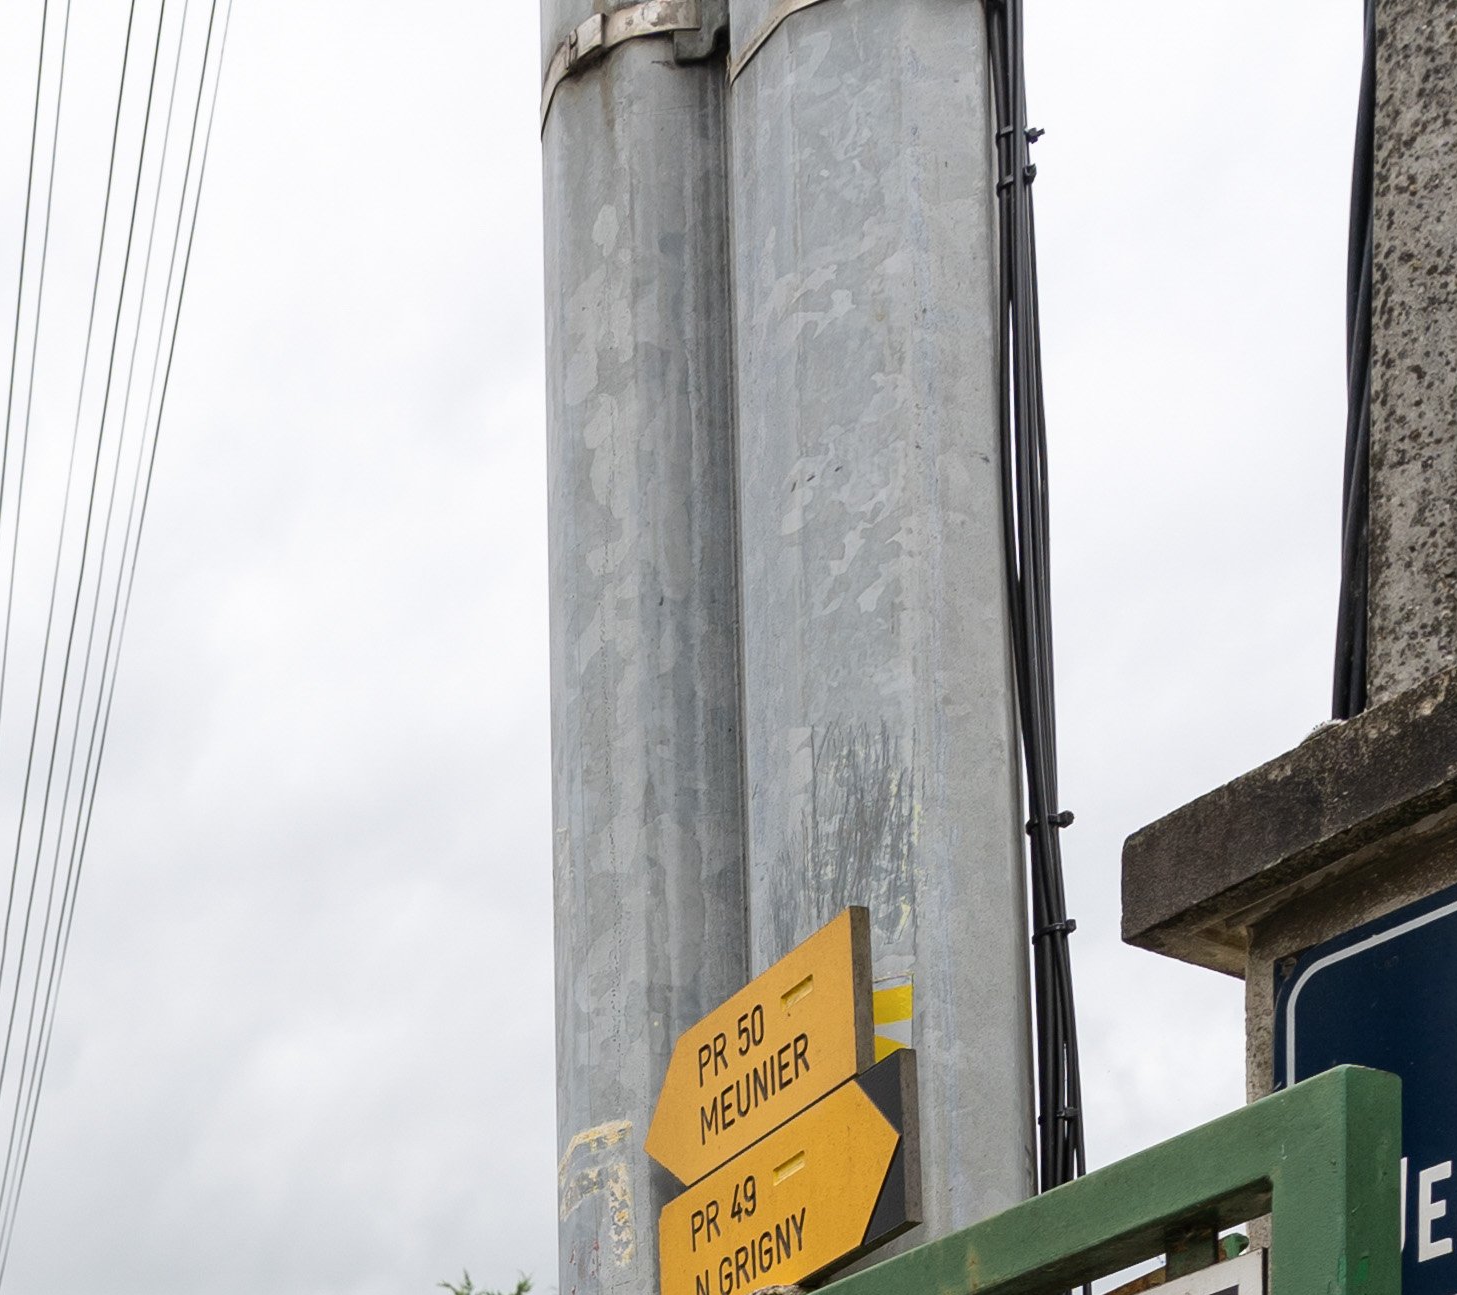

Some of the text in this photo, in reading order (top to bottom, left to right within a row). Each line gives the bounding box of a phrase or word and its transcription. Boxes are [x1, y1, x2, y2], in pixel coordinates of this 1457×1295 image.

[699, 1005, 764, 1087] PR 50
[701, 1033, 809, 1145] MEUNIER
[692, 1176, 756, 1252] PR 49
